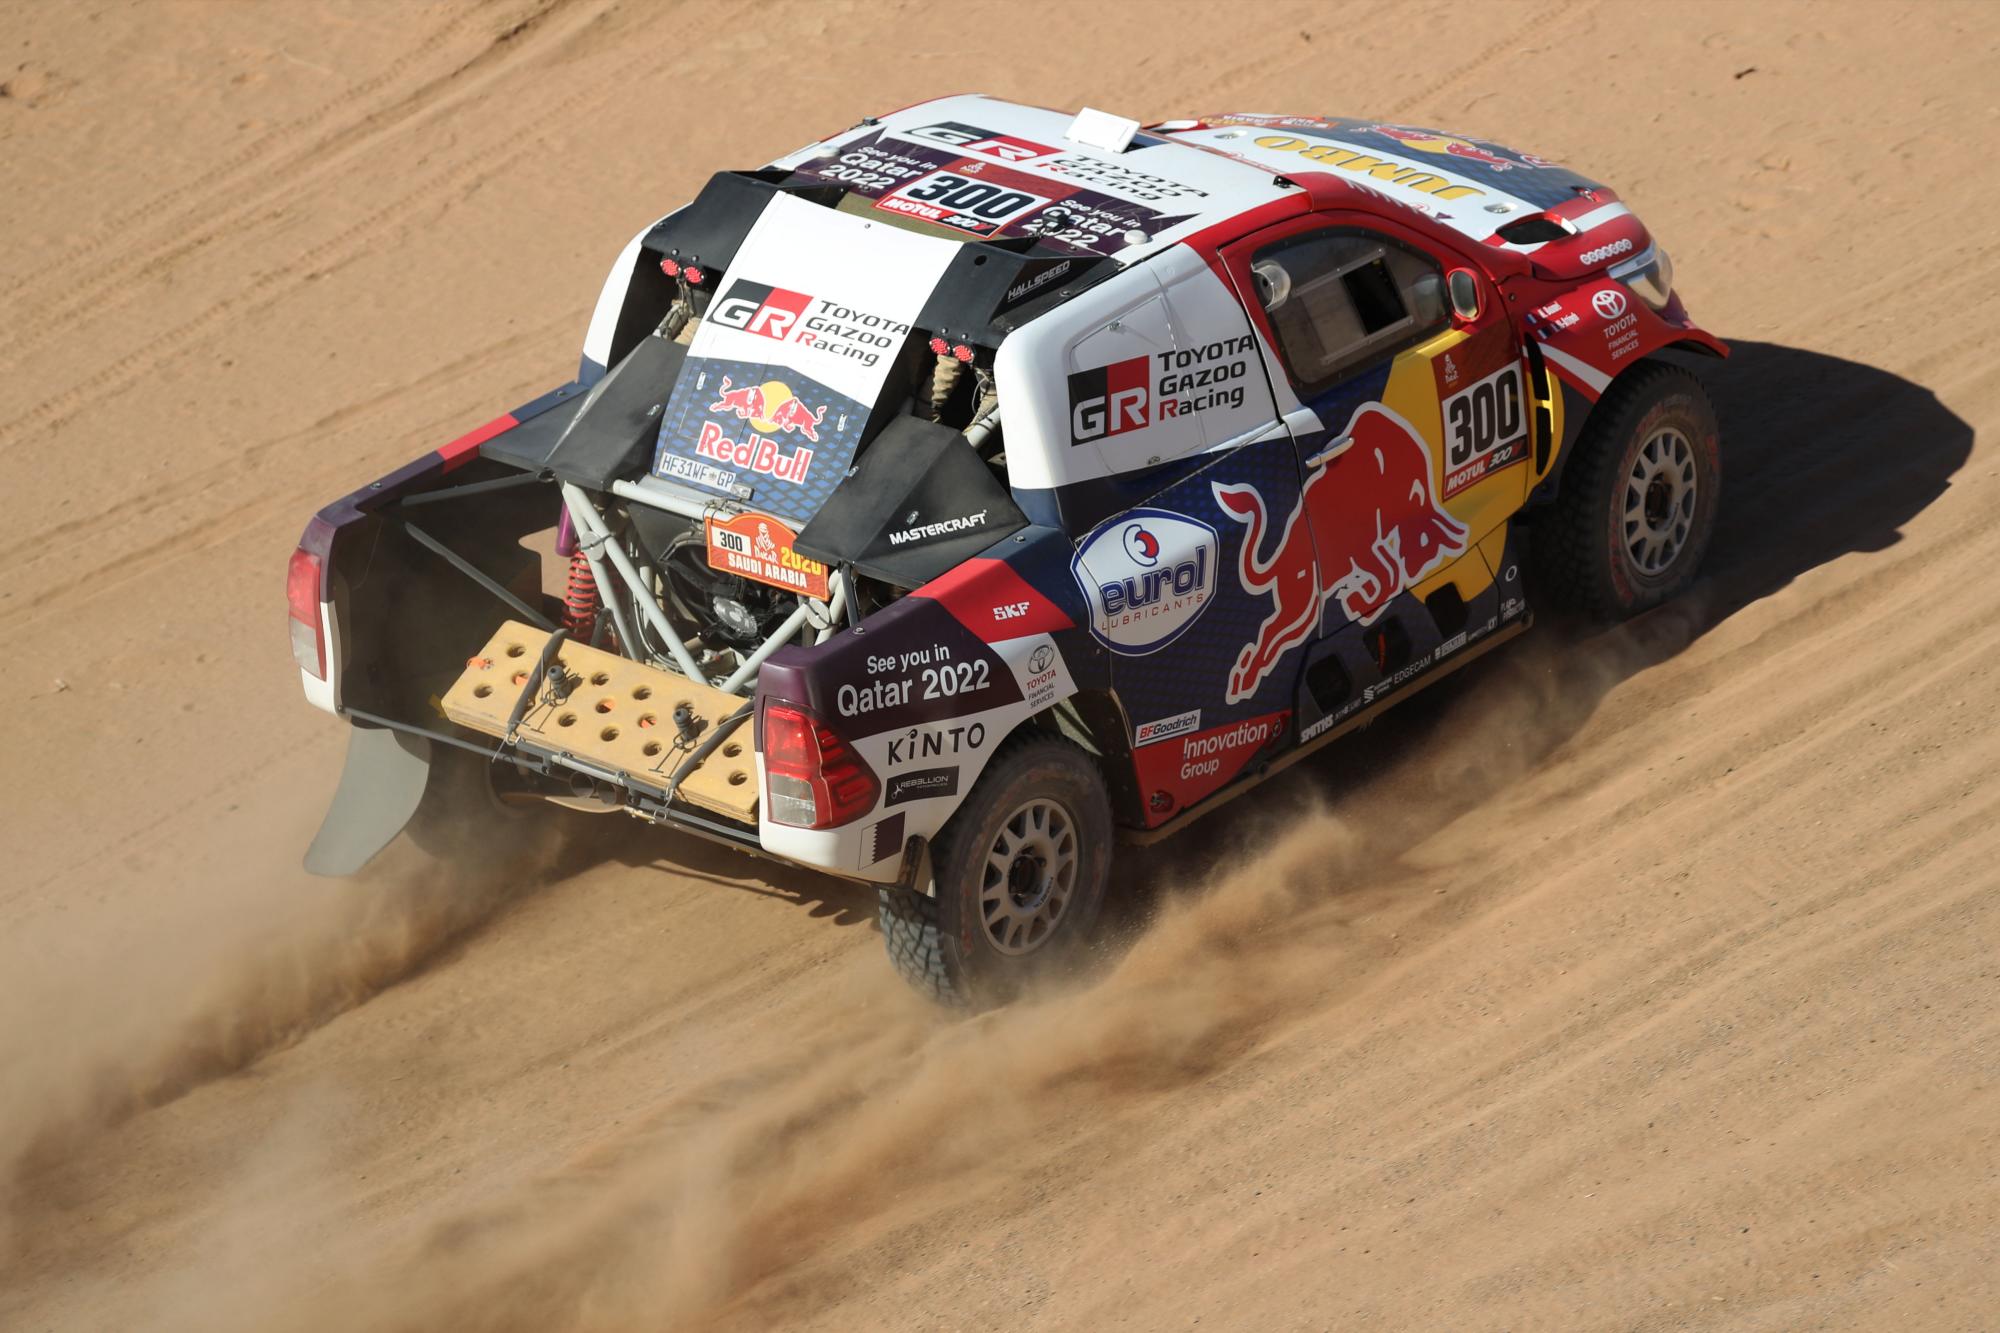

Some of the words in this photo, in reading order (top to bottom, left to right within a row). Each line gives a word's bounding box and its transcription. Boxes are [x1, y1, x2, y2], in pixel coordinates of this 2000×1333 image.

[858, 147, 888, 158] See
[886, 153, 920, 166] you
[919, 161, 938, 170] in
[911, 126, 1038, 162] GR
[819, 165, 896, 189] 2022
[840, 153, 923, 178] Qatar
[1036, 163, 1162, 201] Racing
[1053, 159, 1182, 197] GAZOO
[1077, 155, 1209, 197] TOYOTA
[1253, 136, 1487, 200] JUMBO
[883, 198, 943, 218] MOTUL
[907, 176, 1035, 219] 300
[1060, 200, 1091, 211] See
[1088, 210, 1124, 221] you
[1123, 218, 1142, 228] in
[1008, 260, 1071, 299] HALLSPEED
[712, 298, 797, 339] GR
[806, 317, 892, 348] GAZOO
[820, 300, 910, 335] TOYOTA
[1603, 313, 1637, 338] TOYOTA
[795, 331, 880, 367] Racing
[1158, 335, 1254, 372] TOYOTA
[1159, 361, 1246, 396] GAZOO
[1073, 386, 1147, 440] GR
[1159, 386, 1244, 421] Racing
[1450, 370, 1520, 465] 300
[696, 421, 760, 469] Red
[752, 438, 813, 485] Bull
[1446, 460, 1486, 491] MOTUL
[720, 532, 742, 552] 300
[889, 512, 986, 545] MASTERCRAFT
[728, 553, 762, 575] SAUDI
[765, 563, 807, 588] ARABIA
[1099, 545, 1206, 616] eurol
[993, 601, 1030, 621] SKF
[1102, 593, 1204, 630] LUBRICANTS
[867, 655, 896, 674] See
[900, 649, 930, 672] you
[934, 643, 950, 661] in
[837, 679, 913, 717] Qatar
[921, 659, 990, 700] 2022
[1026, 669, 1056, 690] TOYOTA
[1139, 714, 1197, 739] BFGoodrich
[1184, 722, 1267, 759] Innovation
[1181, 758, 1219, 780] Group
